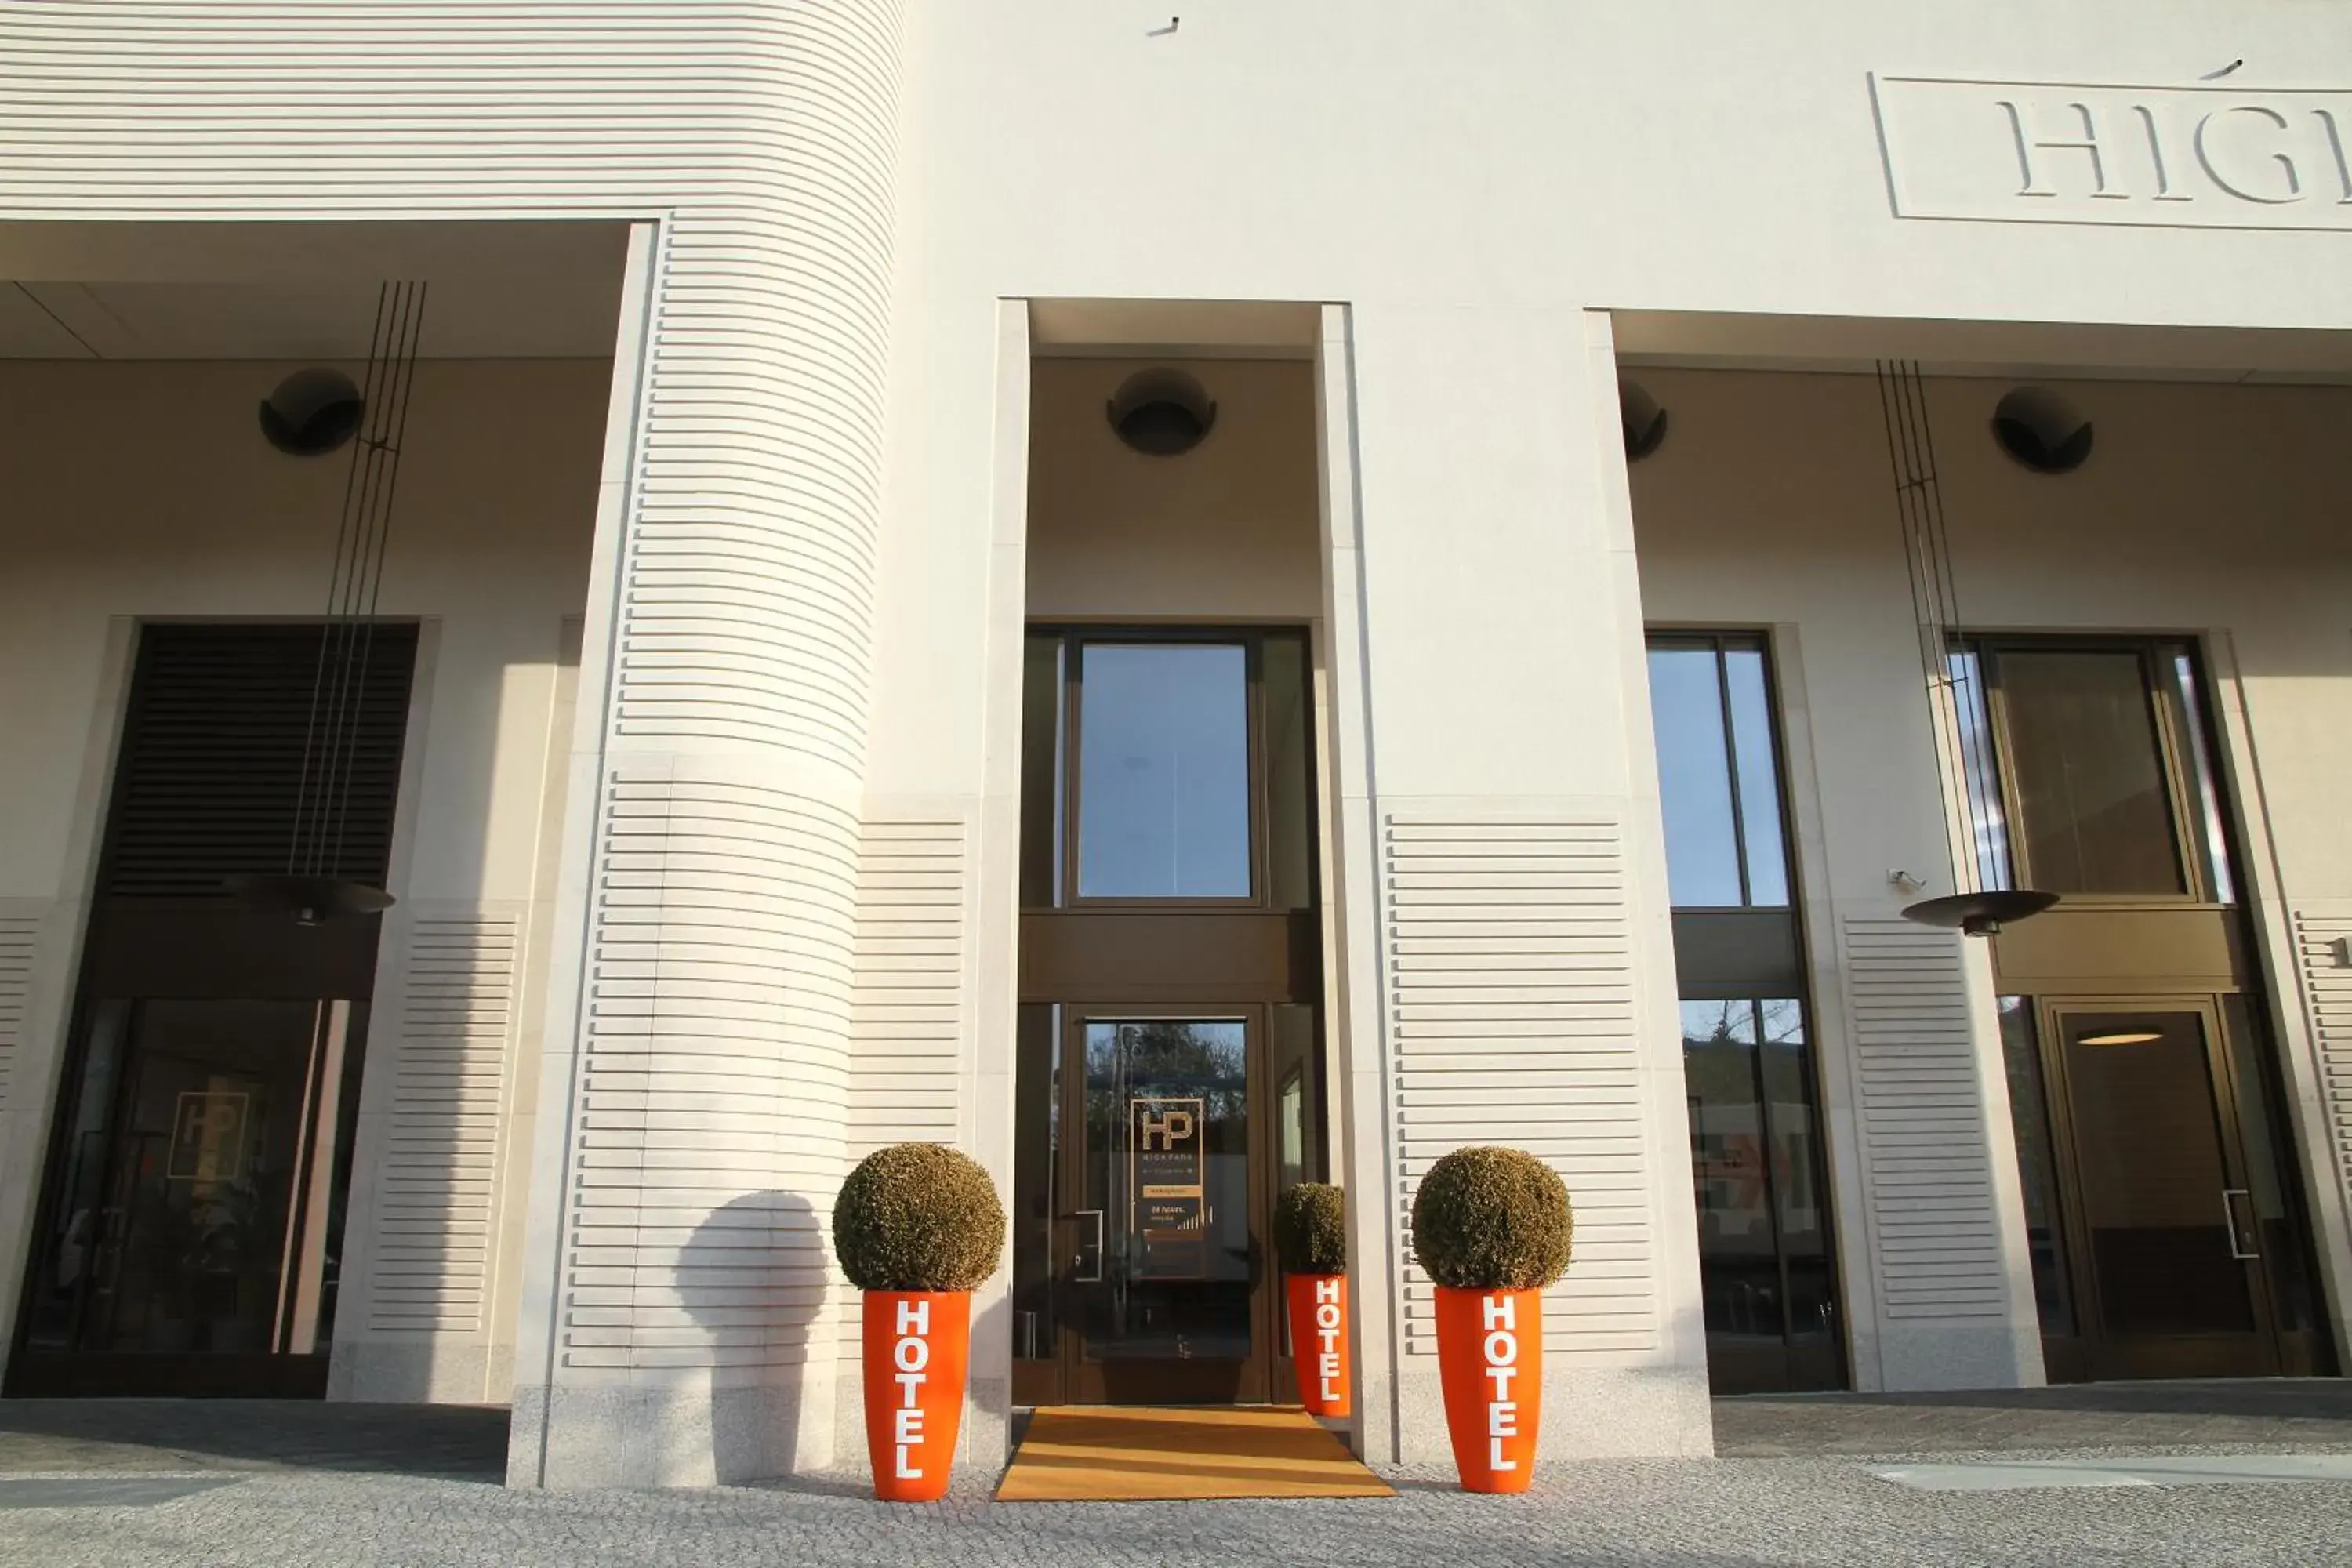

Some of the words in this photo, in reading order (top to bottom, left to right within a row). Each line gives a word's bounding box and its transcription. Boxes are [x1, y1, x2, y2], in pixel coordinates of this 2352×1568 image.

[1142, 1111, 1192, 1150] HP
[895, 1301, 929, 1479] HOTEL
[1316, 1279, 1341, 1401] HOTEL
[1483, 1295, 1518, 1471] HOTEL
